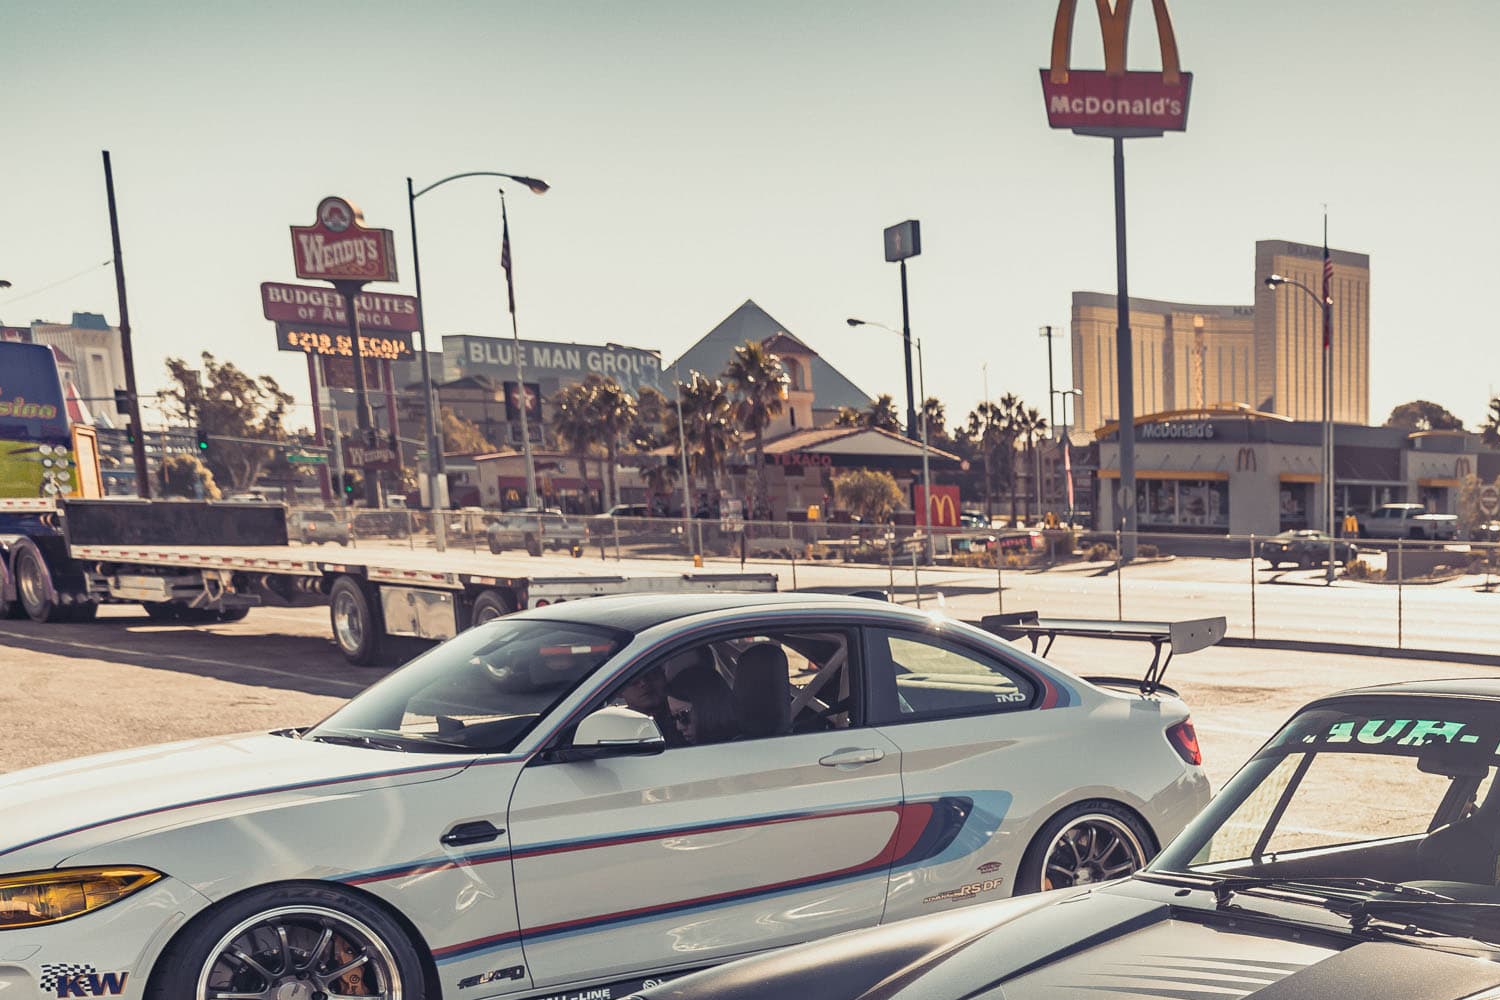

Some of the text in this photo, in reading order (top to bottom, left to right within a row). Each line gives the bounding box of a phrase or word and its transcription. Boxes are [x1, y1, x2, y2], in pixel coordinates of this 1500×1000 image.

[1051, 96, 1181, 116] McDonald's
[299, 233, 378, 274] Wendy's
[267, 288, 346, 309] BUDGET
[298, 307, 392, 326] OF AMRICA
[469, 342, 658, 374] BLUE MAN GROUP
[1142, 423, 1214, 438] McDonald's
[774, 453, 832, 466] TEXACO
[57, 971, 130, 999] KW
